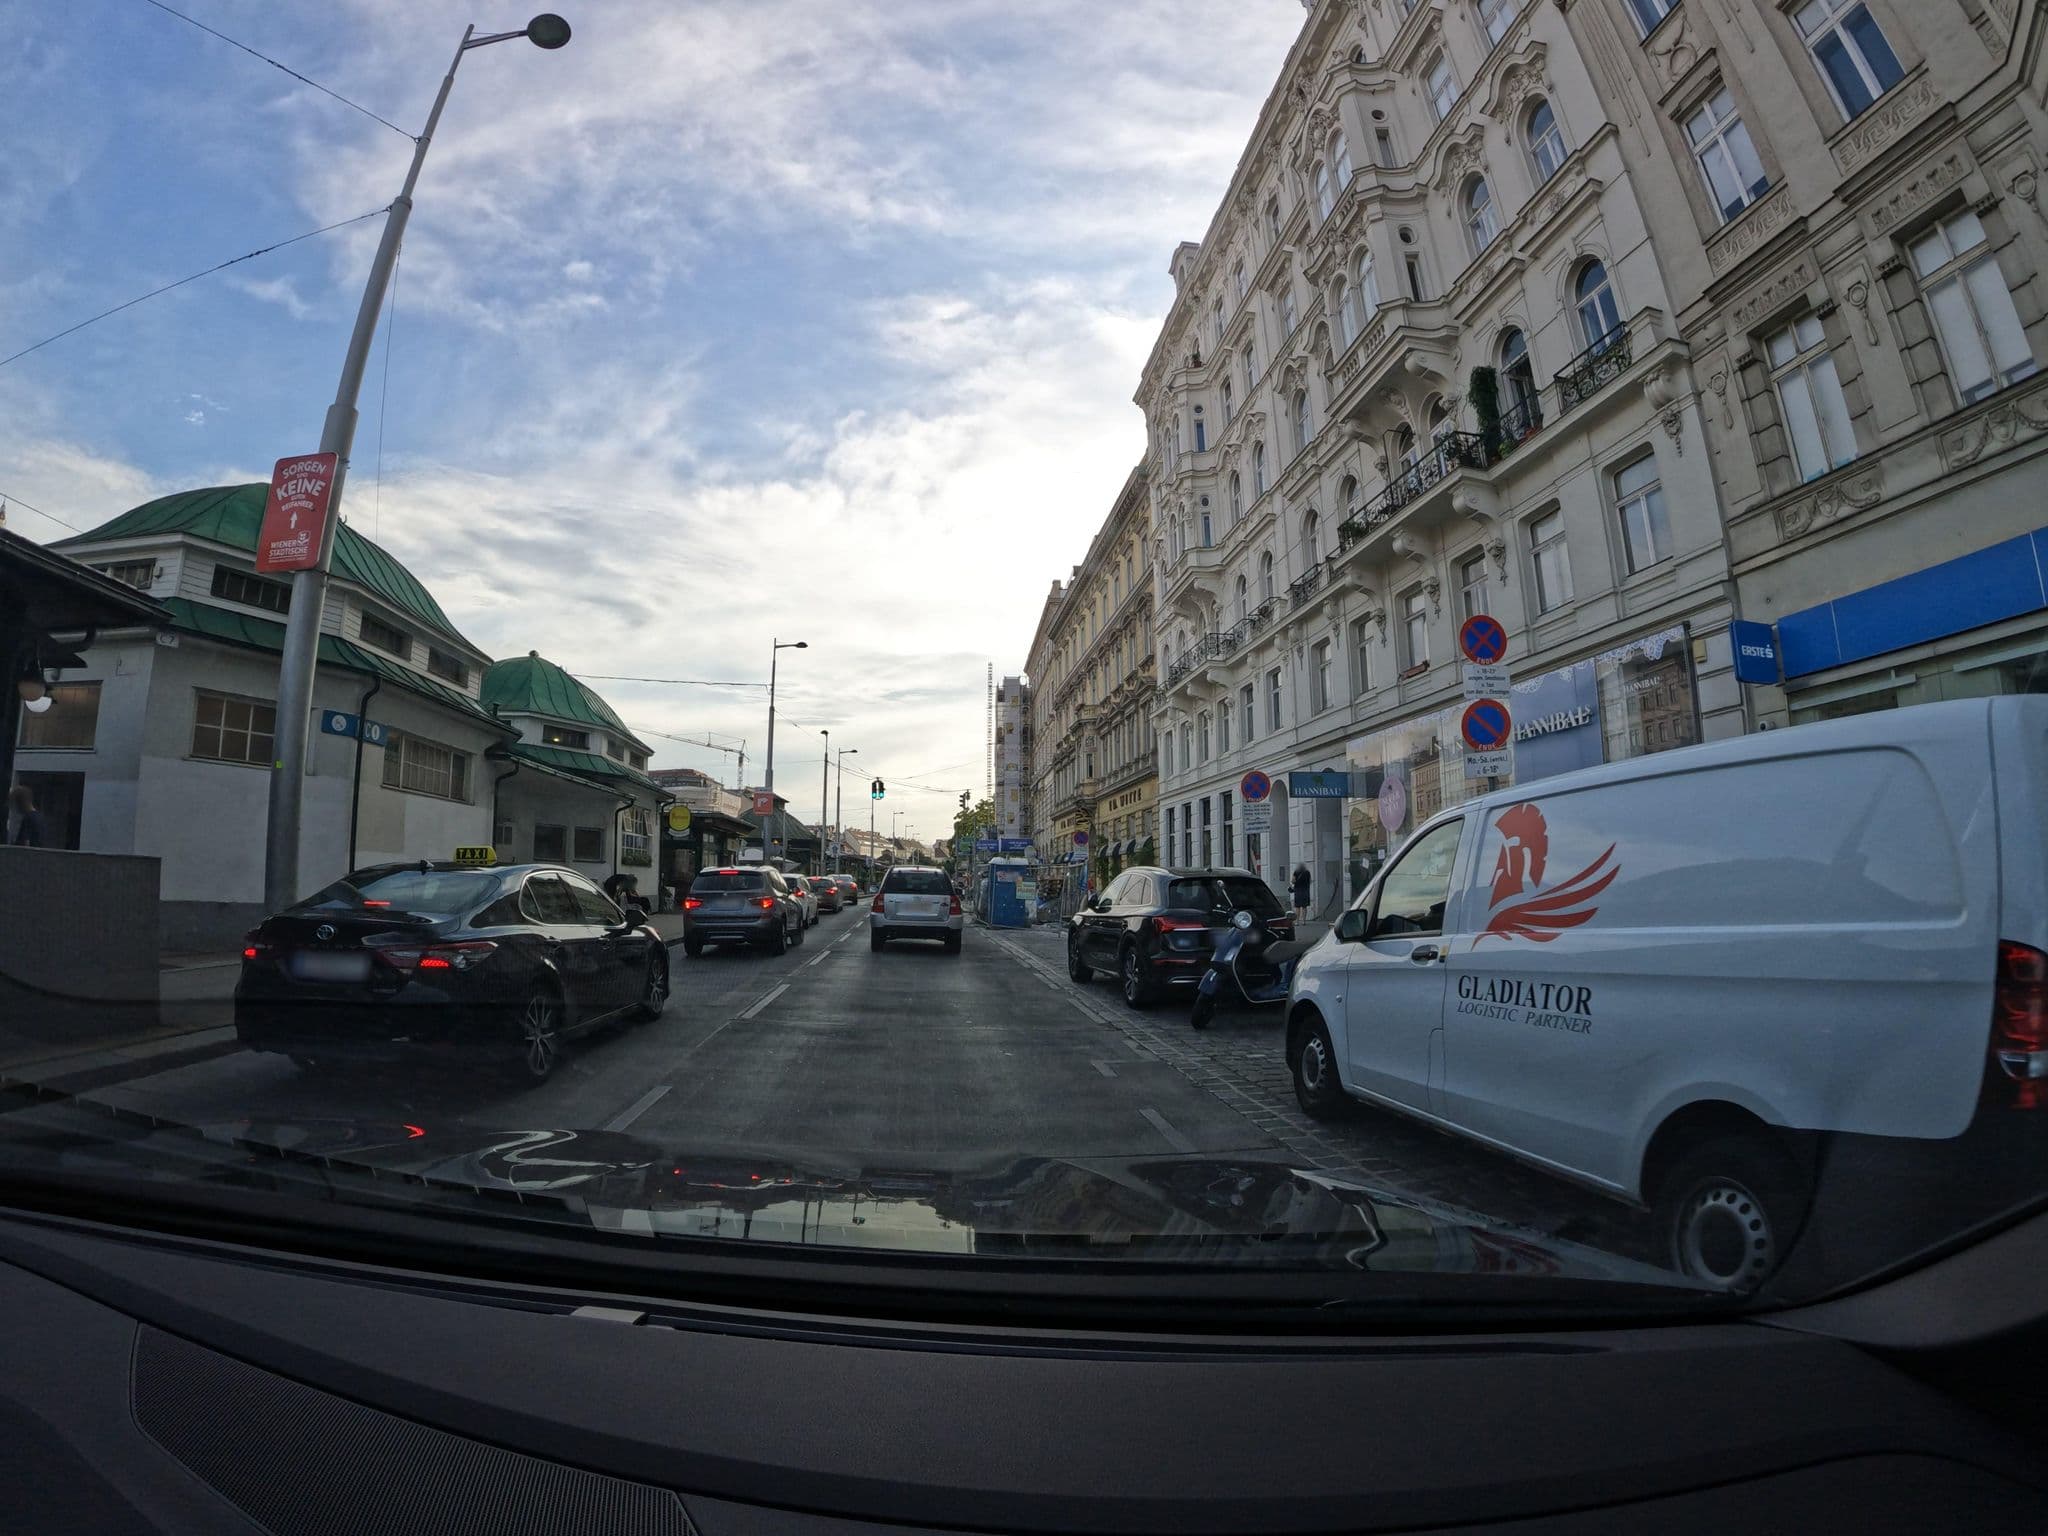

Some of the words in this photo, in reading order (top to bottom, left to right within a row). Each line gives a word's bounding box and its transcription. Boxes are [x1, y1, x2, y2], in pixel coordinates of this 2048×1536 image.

[282, 461, 326, 479] SORGEN
[276, 478, 326, 501] KEINE
[1741, 645, 1765, 658] ERSTE
[1479, 743, 1498, 752] ENDE
[459, 848, 486, 859] TAXI
[1458, 974, 1593, 1016] GLADIATOR
[1457, 1000, 1518, 1023] LOGISTIC
[1524, 1011, 1593, 1035] PARTNER
